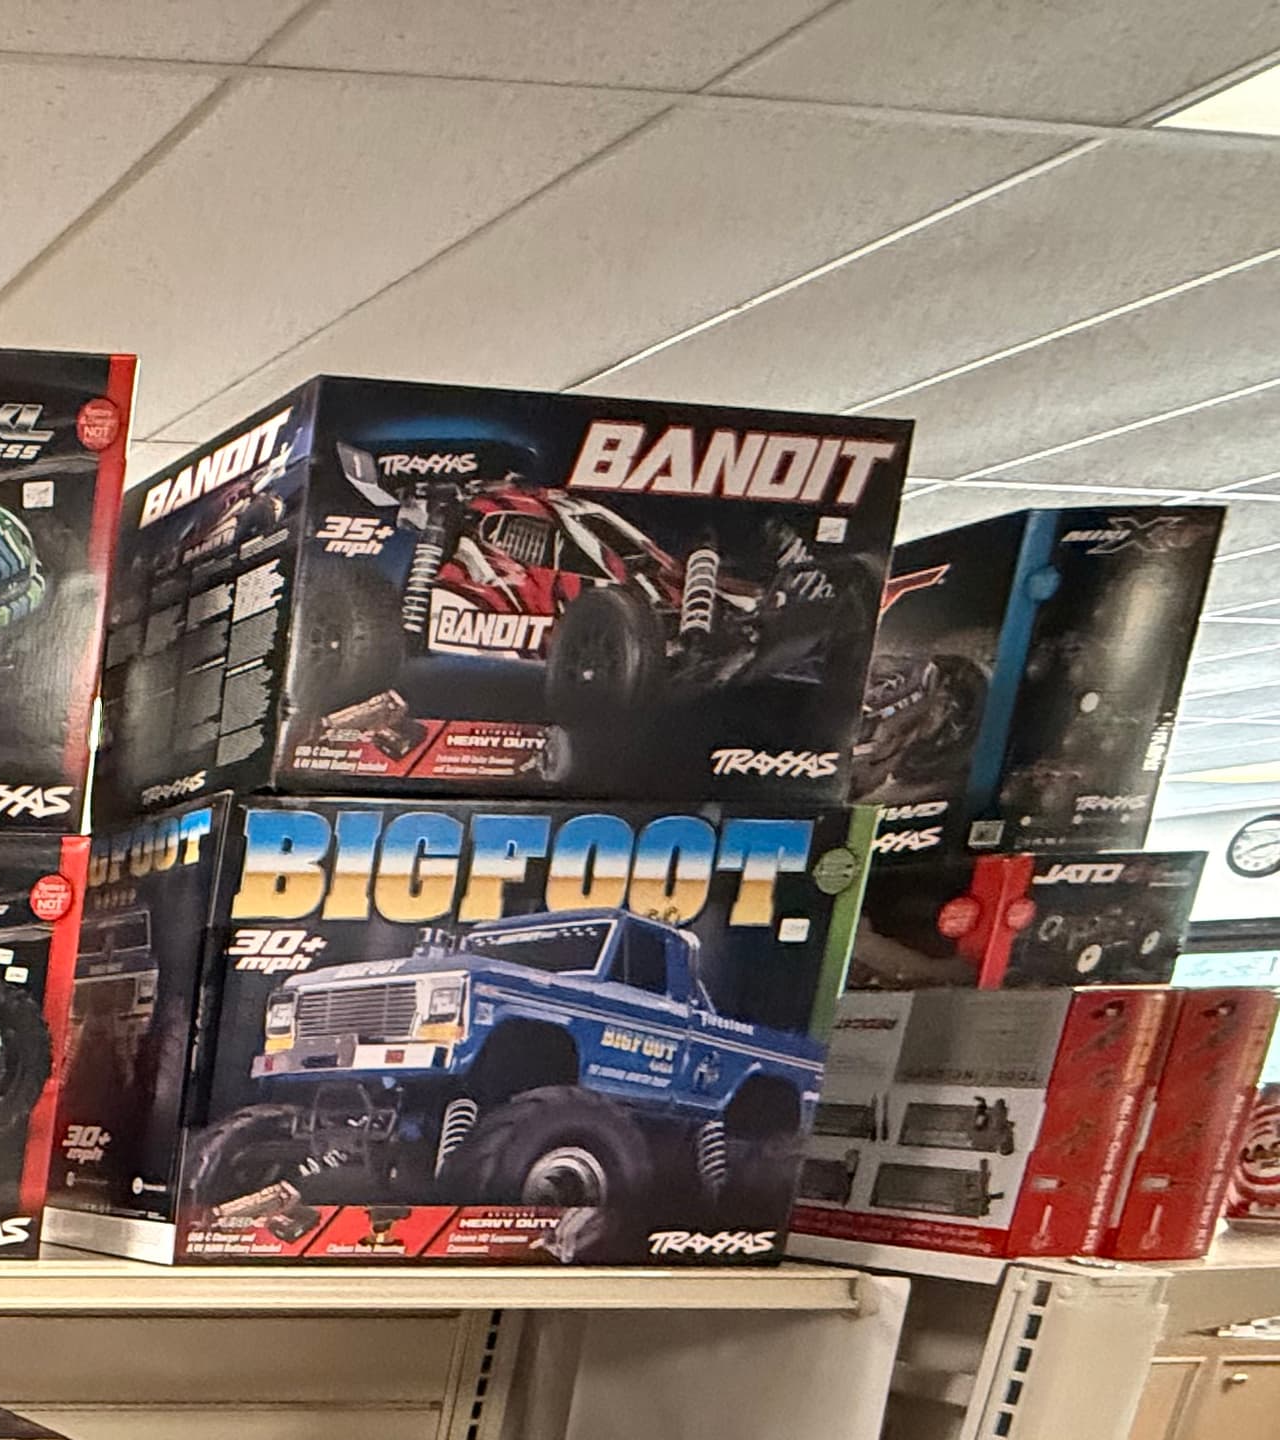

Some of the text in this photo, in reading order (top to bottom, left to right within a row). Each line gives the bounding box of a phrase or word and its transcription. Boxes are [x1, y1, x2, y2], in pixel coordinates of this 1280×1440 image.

[139, 406, 294, 530] BANDIT
[378, 453, 477, 477] TRAXXAS
[569, 420, 899, 507] BANDIT
[315, 515, 395, 541] 35+
[325, 540, 384, 558] mph
[436, 607, 554, 651] BANDIT
[446, 736, 547, 750] HEAVY DUTY
[710, 748, 840, 777] TRAXXAS
[232, 808, 815, 928] BIGFOOT
[1032, 863, 1125, 884] JATO
[225, 929, 328, 956] 30+
[236, 955, 313, 975] mph
[691, 1009, 755, 1036] Firestone
[600, 1024, 679, 1061] BIGFOOT
[61, 1124, 113, 1149] 30+
[459, 1218, 560, 1229] HEAVY DUTY
[648, 1231, 779, 1255] TRAXXAS
